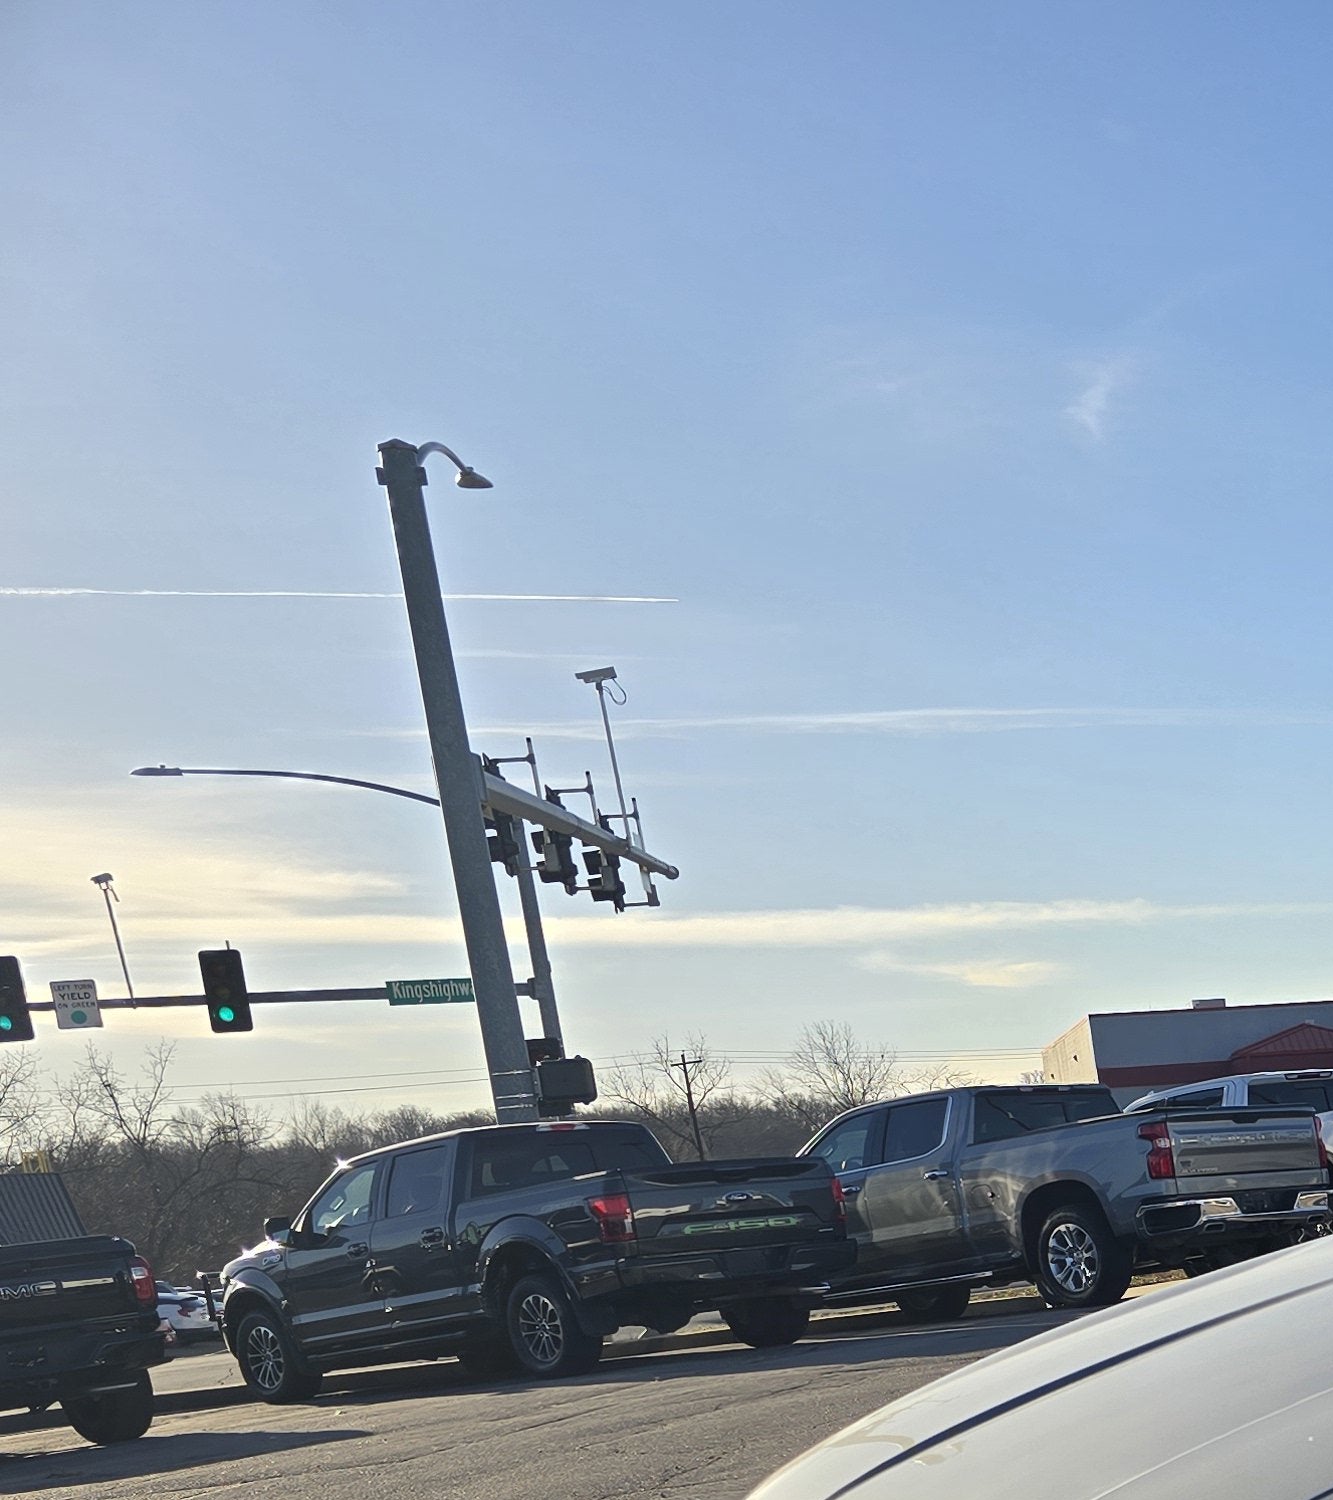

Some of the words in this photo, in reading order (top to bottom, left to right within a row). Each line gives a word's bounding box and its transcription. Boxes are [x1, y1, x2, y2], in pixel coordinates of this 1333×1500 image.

[53, 984, 71, 992] LEFT
[391, 980, 475, 1003] Kingshighw
[59, 991, 91, 1001] YIELD
[57, 1002, 69, 1010] ON
[71, 1000, 96, 1009] GREEN
[0, 1280, 57, 1301] MC
